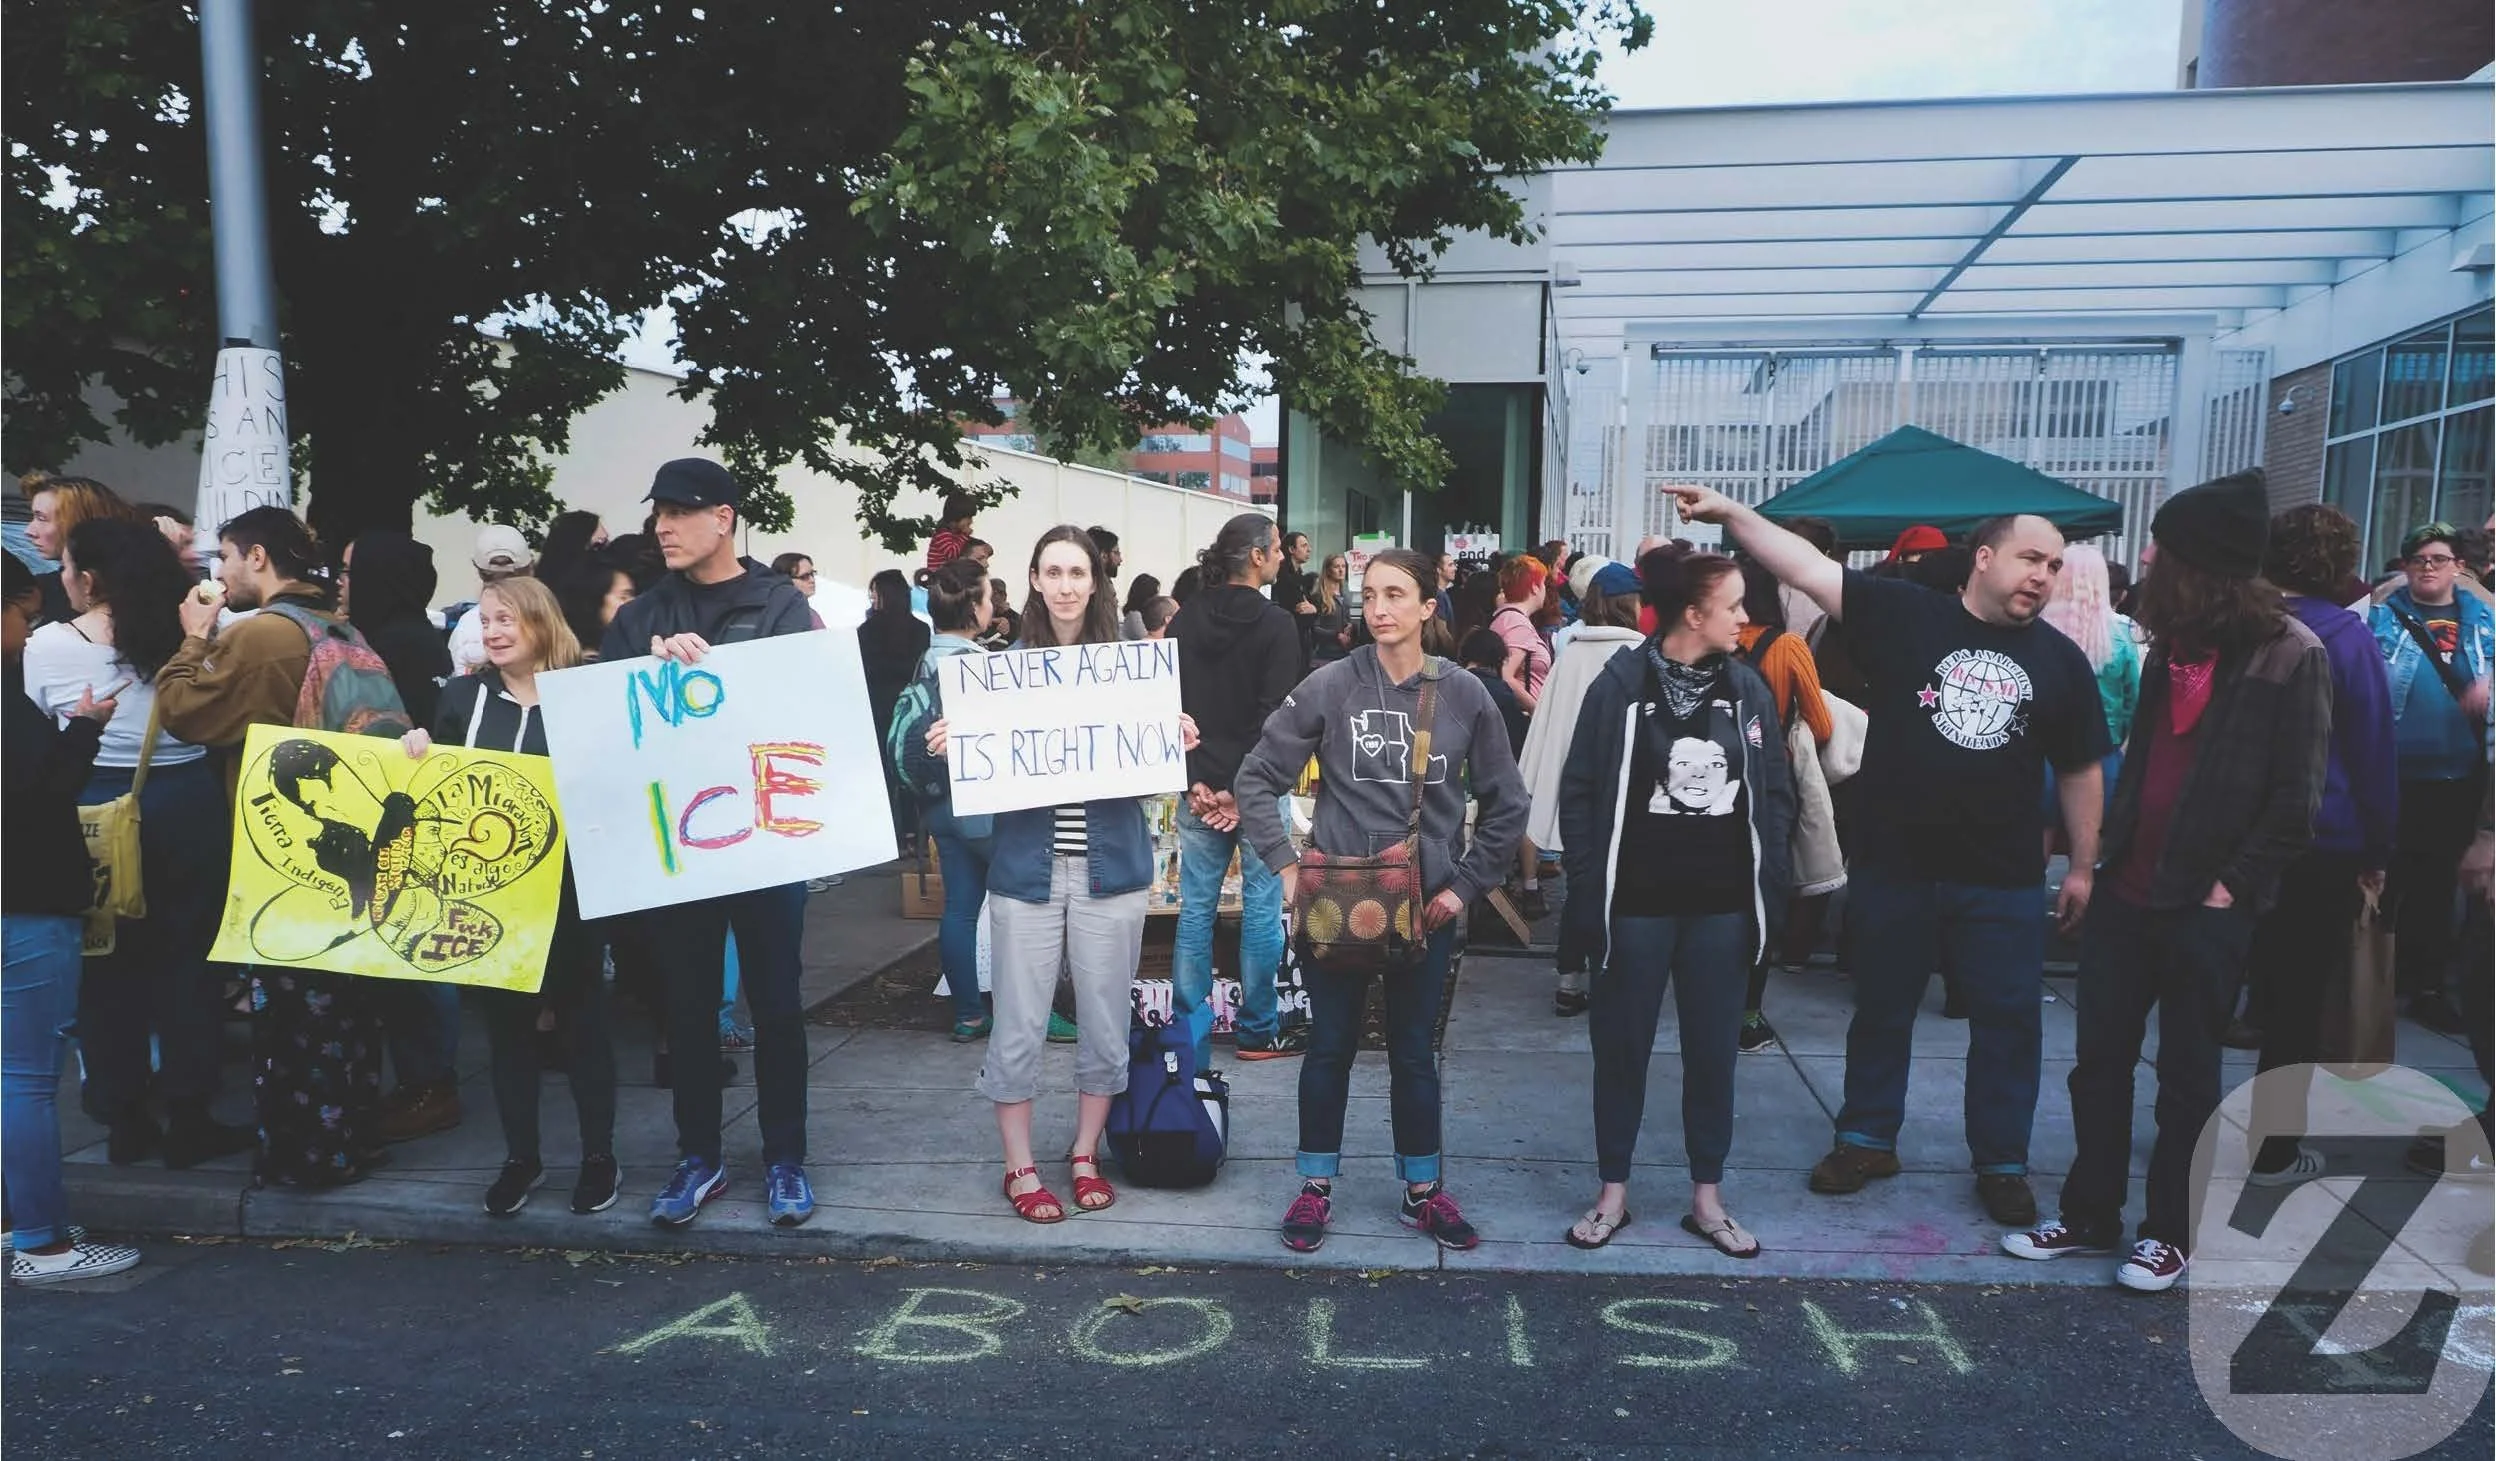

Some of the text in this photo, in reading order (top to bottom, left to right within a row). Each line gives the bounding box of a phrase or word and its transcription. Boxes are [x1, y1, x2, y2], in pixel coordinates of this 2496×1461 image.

[237, 405, 285, 435] AN
[203, 444, 282, 488] ICE
[960, 641, 1173, 693] NEVER AGAIN
[627, 660, 725, 750] NO
[951, 721, 1183, 782] IS RIGHT NOW
[251, 792, 293, 849] Tierra
[648, 742, 826, 877] ICE
[473, 863, 511, 882] algo
[421, 934, 484, 961] ICE
[448, 909, 493, 939] Fuck
[608, 1288, 1977, 1377] ABOLISH
